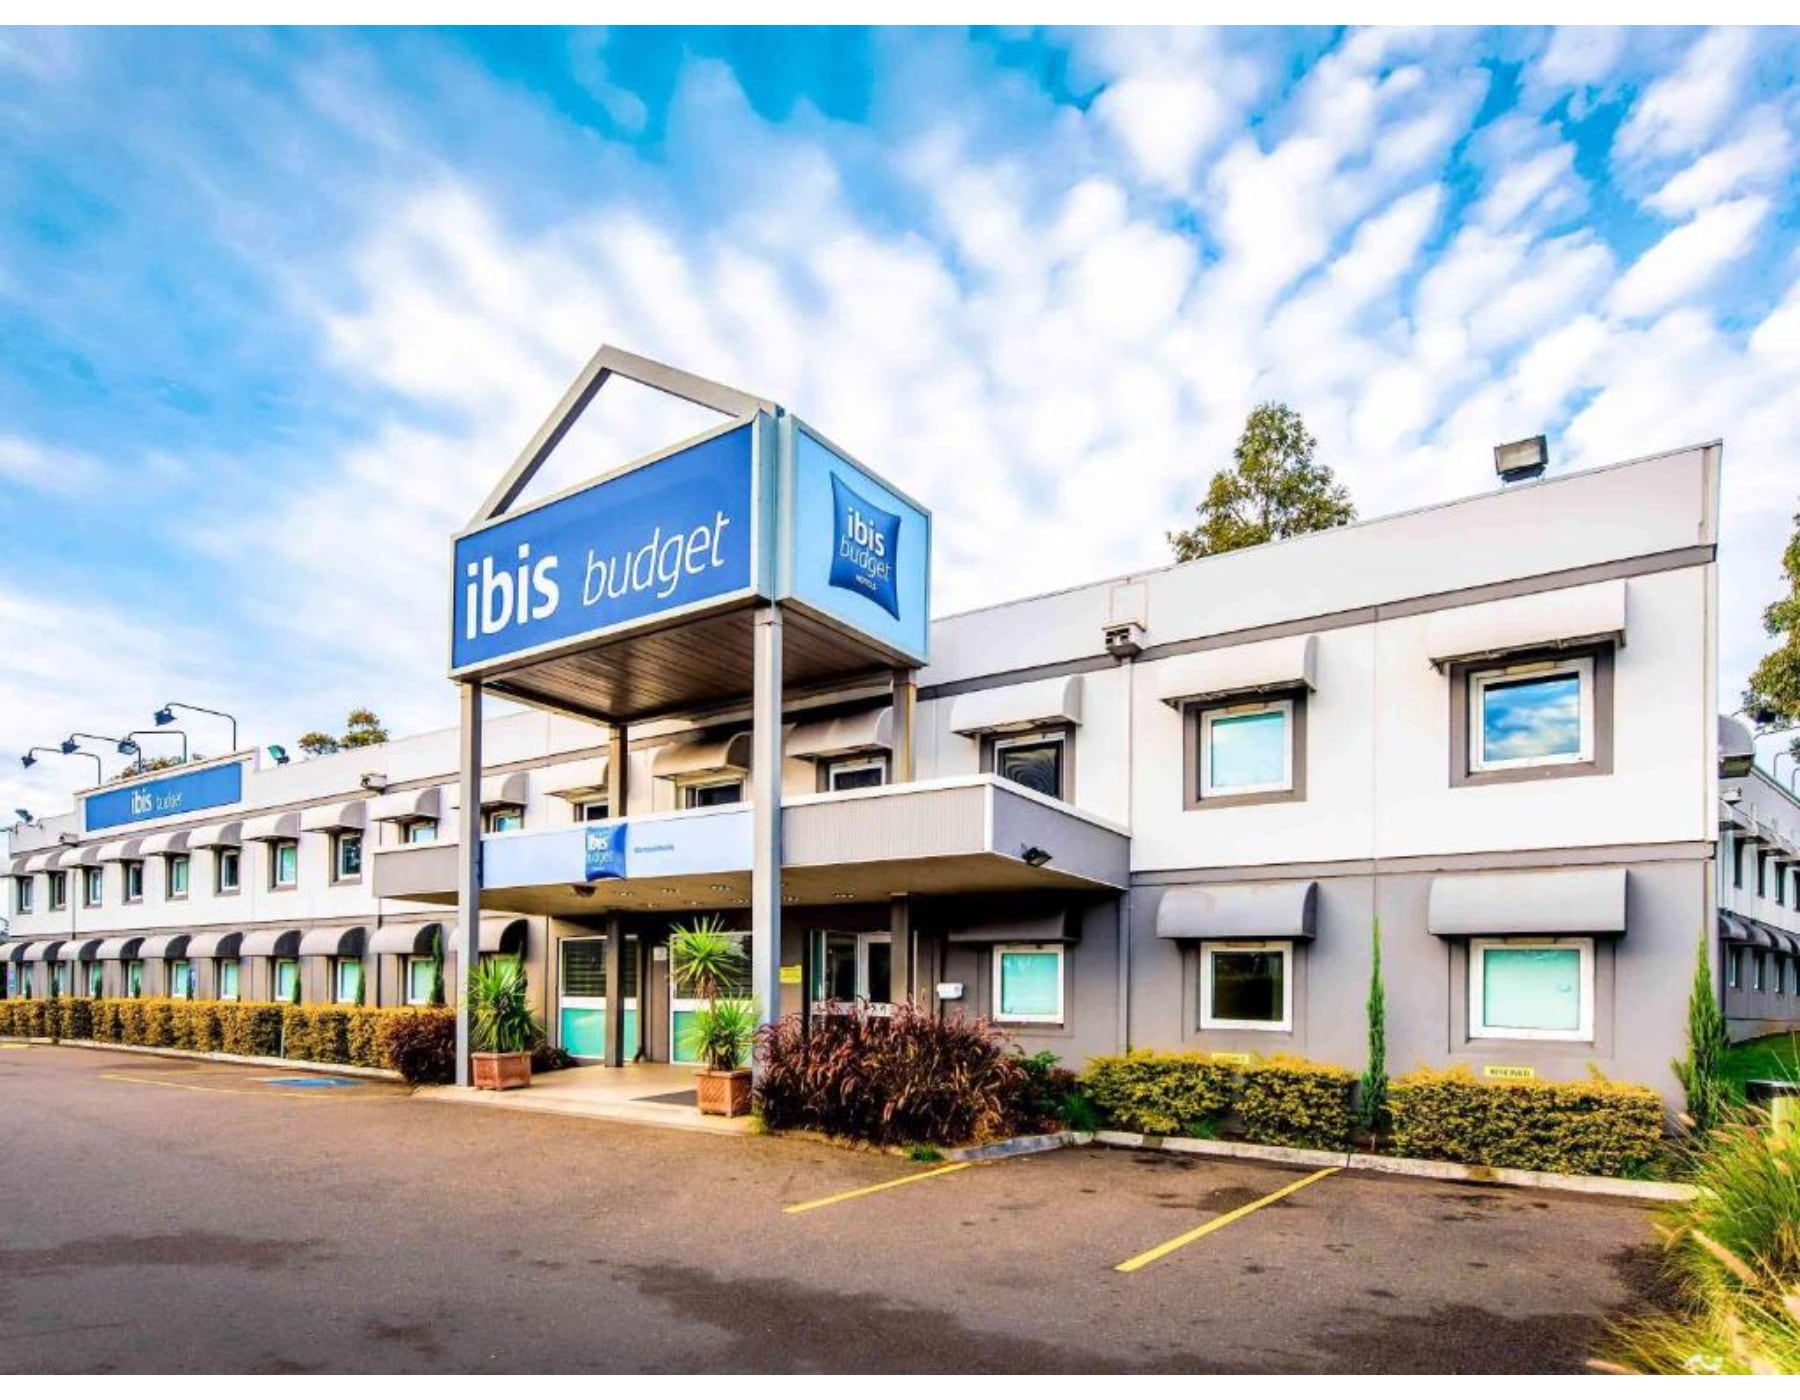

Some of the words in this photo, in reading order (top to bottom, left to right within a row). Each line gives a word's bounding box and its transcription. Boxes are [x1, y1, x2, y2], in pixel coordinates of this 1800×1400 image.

[847, 507, 885, 557] ibis
[466, 543, 560, 640] ibis
[583, 511, 730, 607] budget
[839, 534, 892, 582] budget
[131, 787, 152, 815] ibis
